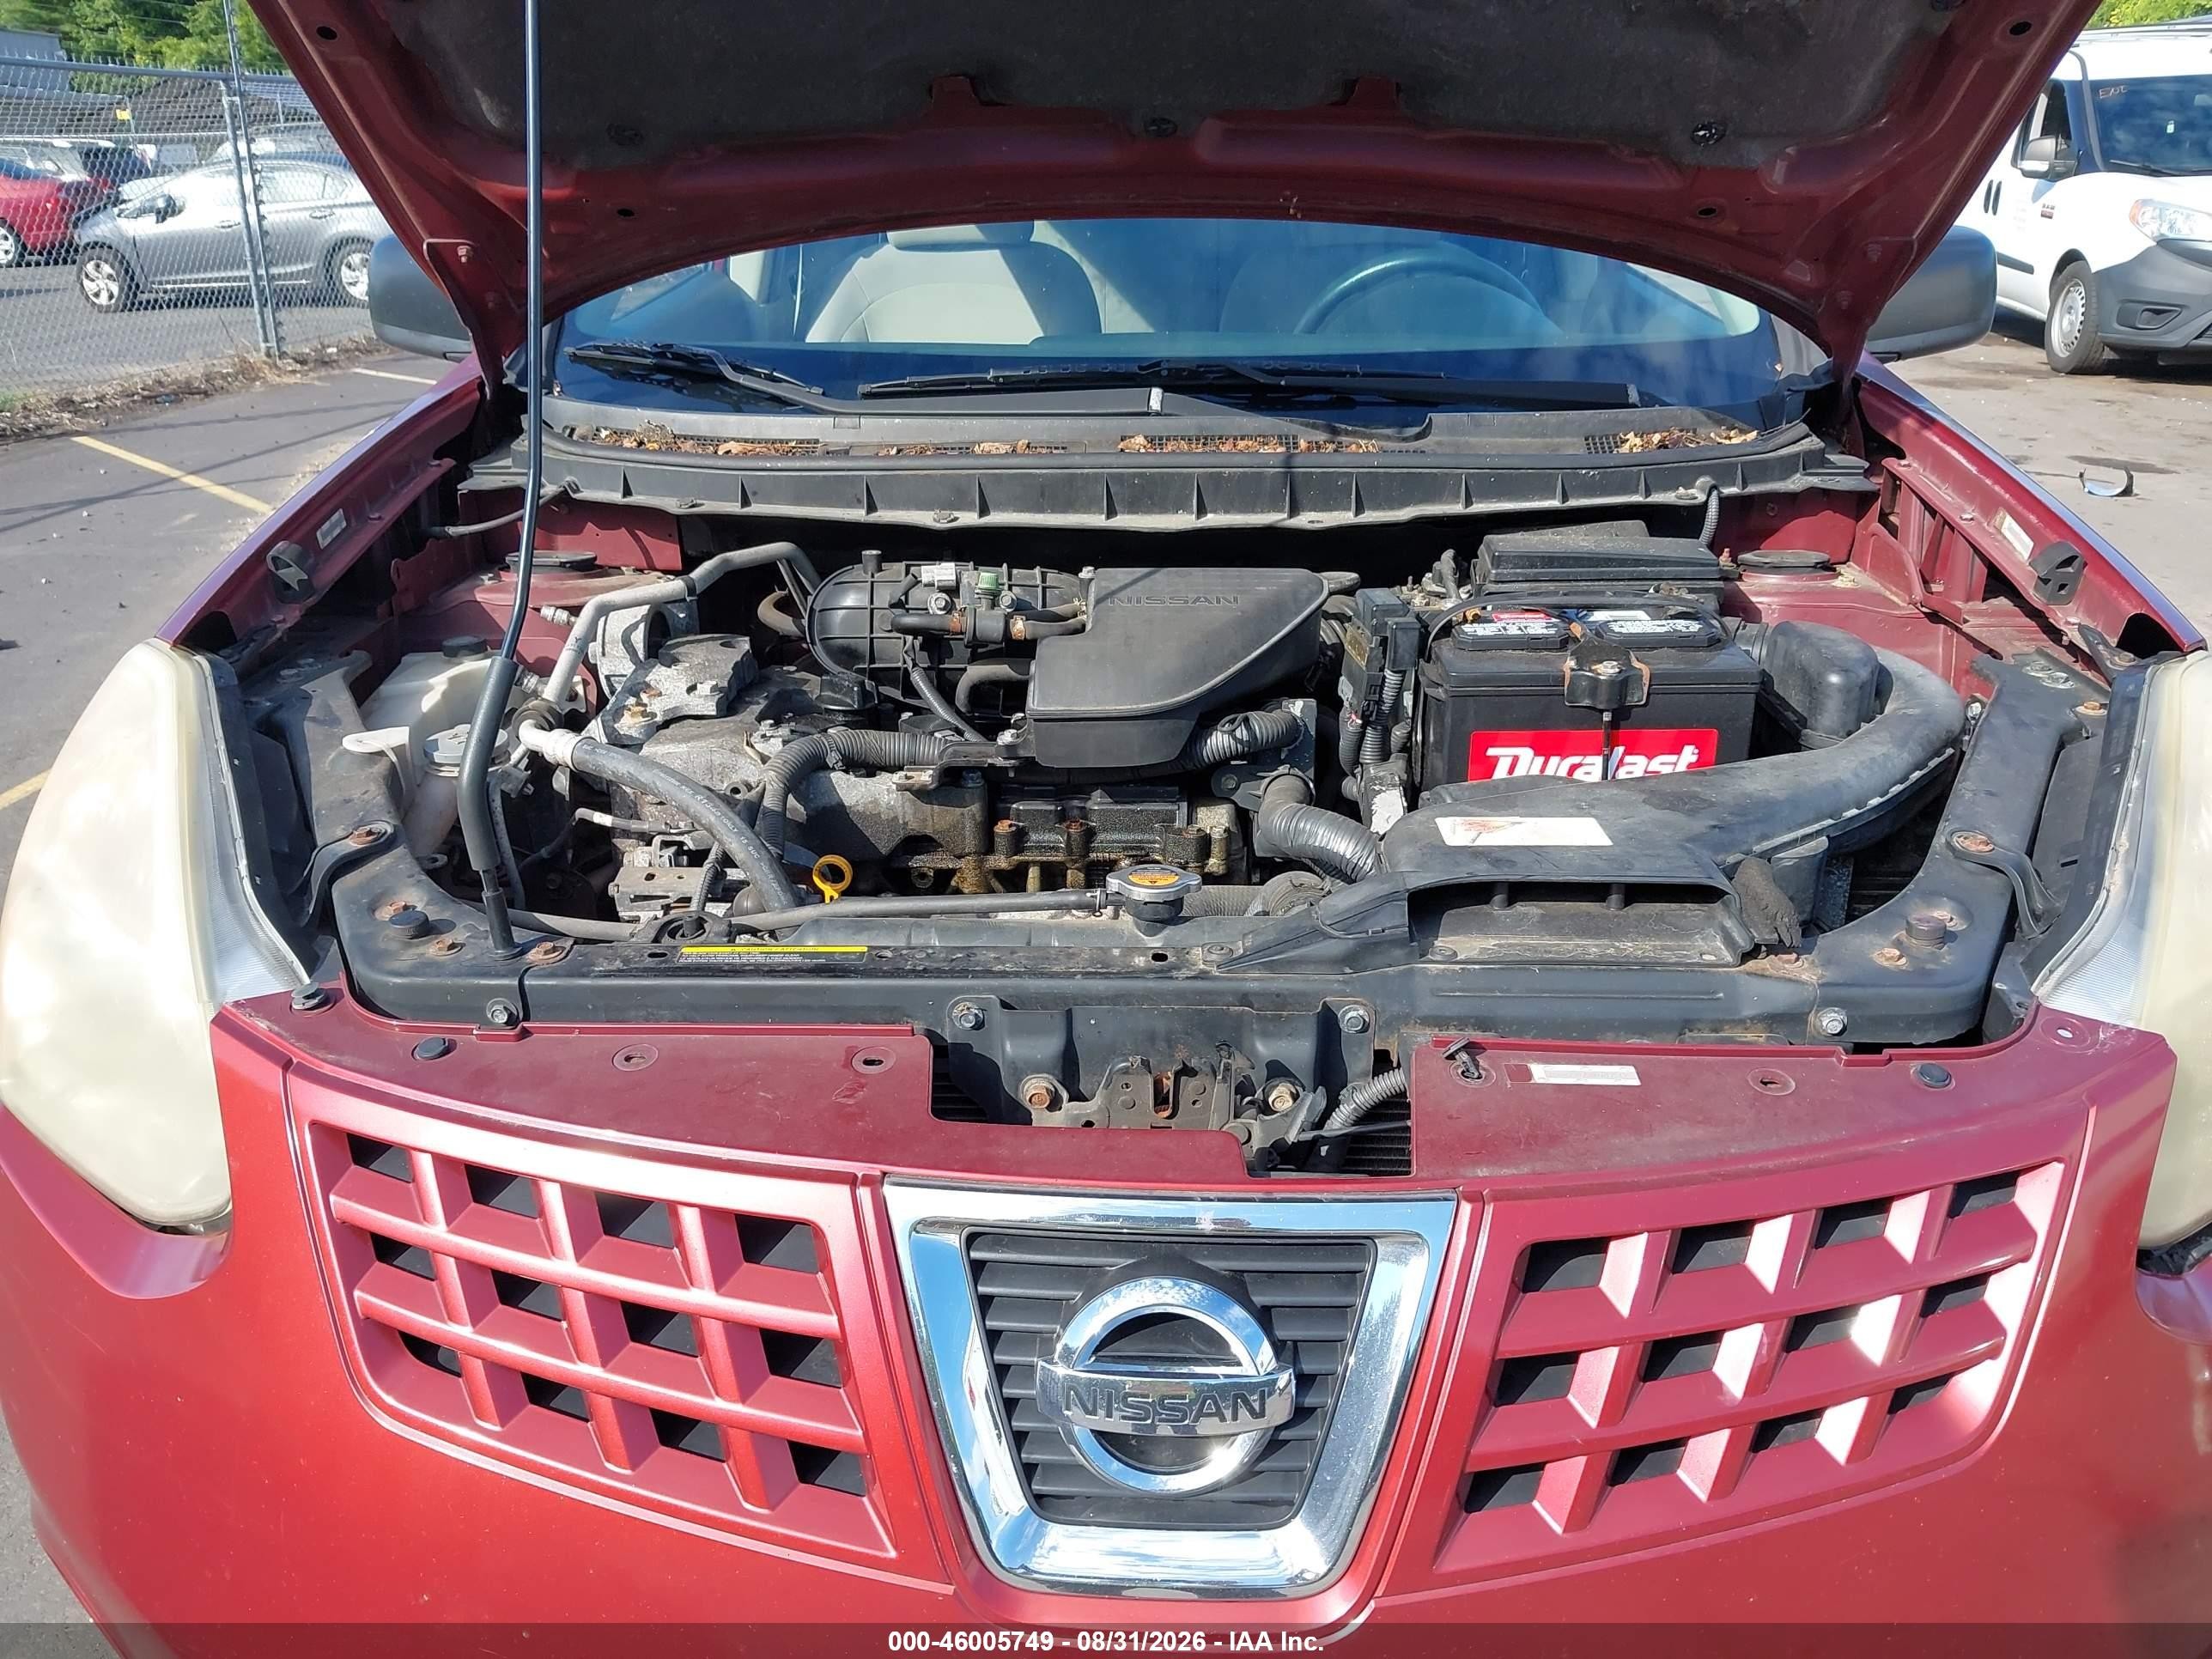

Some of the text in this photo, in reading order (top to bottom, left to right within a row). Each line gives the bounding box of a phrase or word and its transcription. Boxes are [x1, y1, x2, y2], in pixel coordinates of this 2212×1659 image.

[1109, 595, 1240, 606] NISSAN
[1486, 744, 1700, 782] Duralast
[1064, 1382, 1268, 1425] NISSAN
